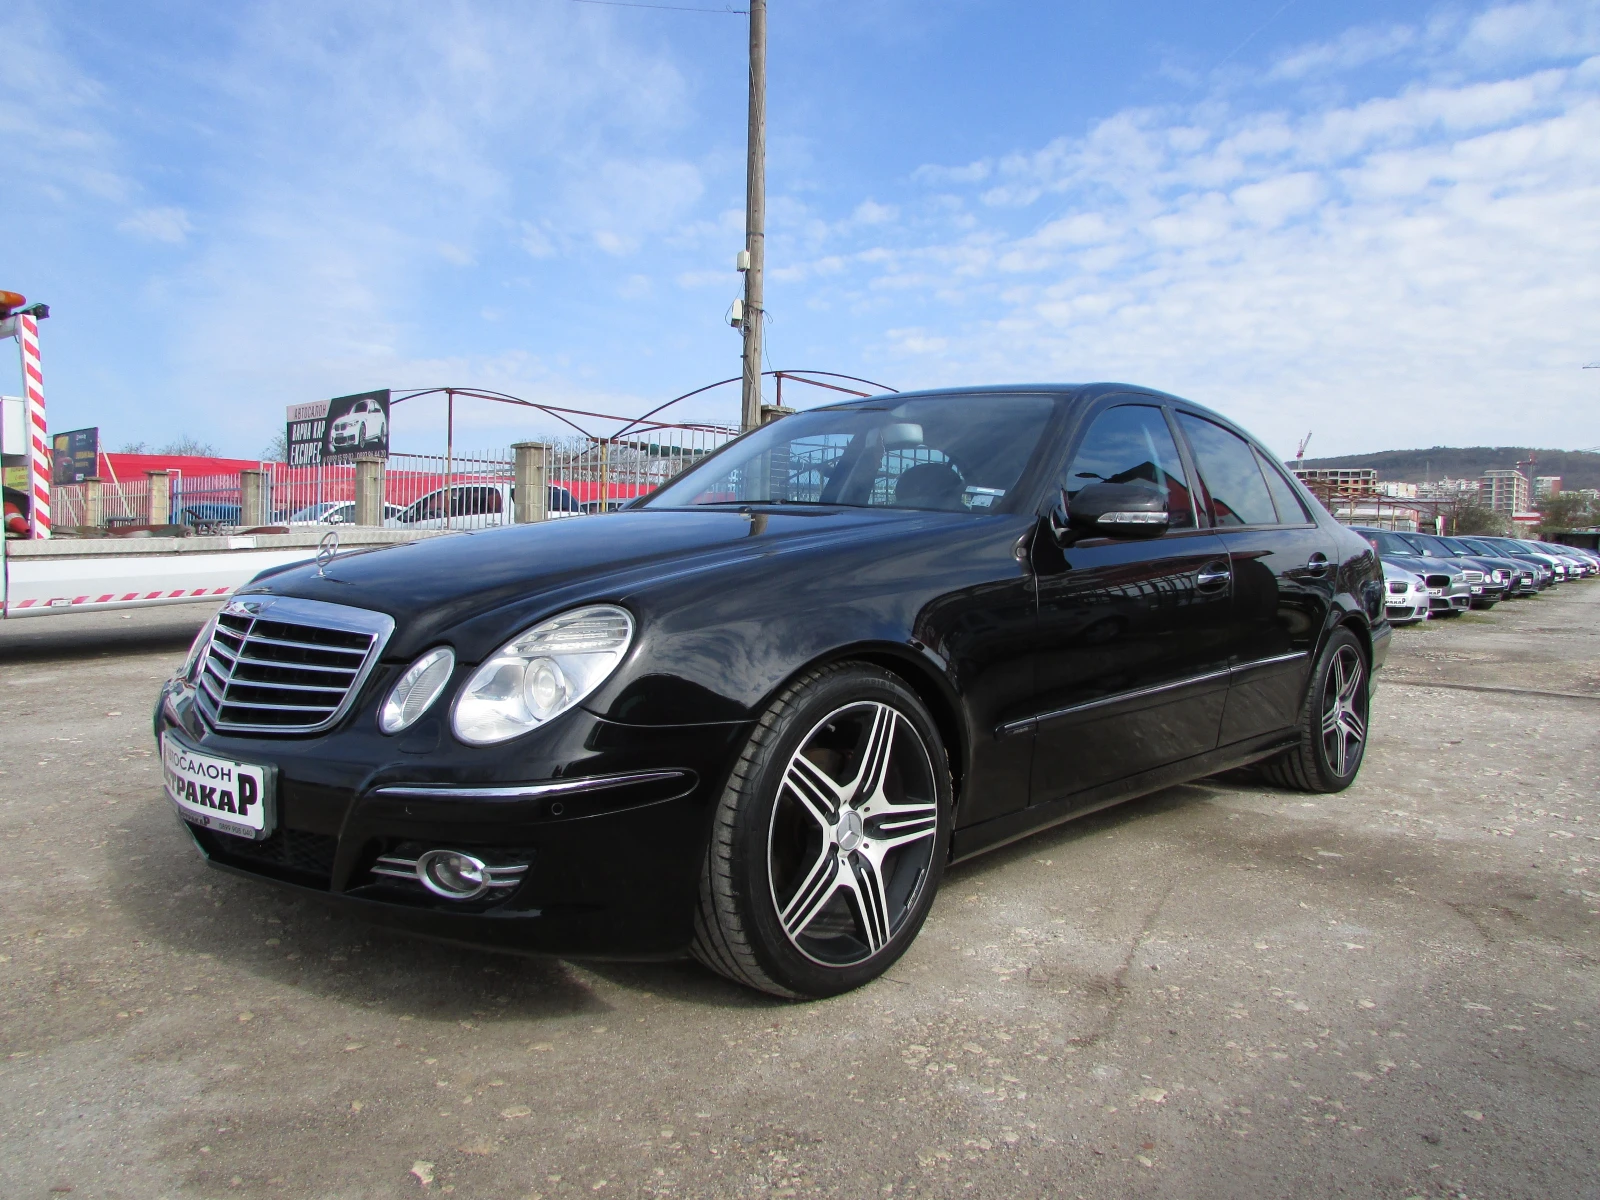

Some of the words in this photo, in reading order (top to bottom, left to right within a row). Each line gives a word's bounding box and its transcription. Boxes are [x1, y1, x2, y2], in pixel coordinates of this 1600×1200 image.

[294, 404, 327, 420] АВТОСАЛОН
[292, 422, 312, 441] ВАРНА
[313, 420, 326, 439] КАР
[290, 441, 323, 465] ЕКСПРЕС
